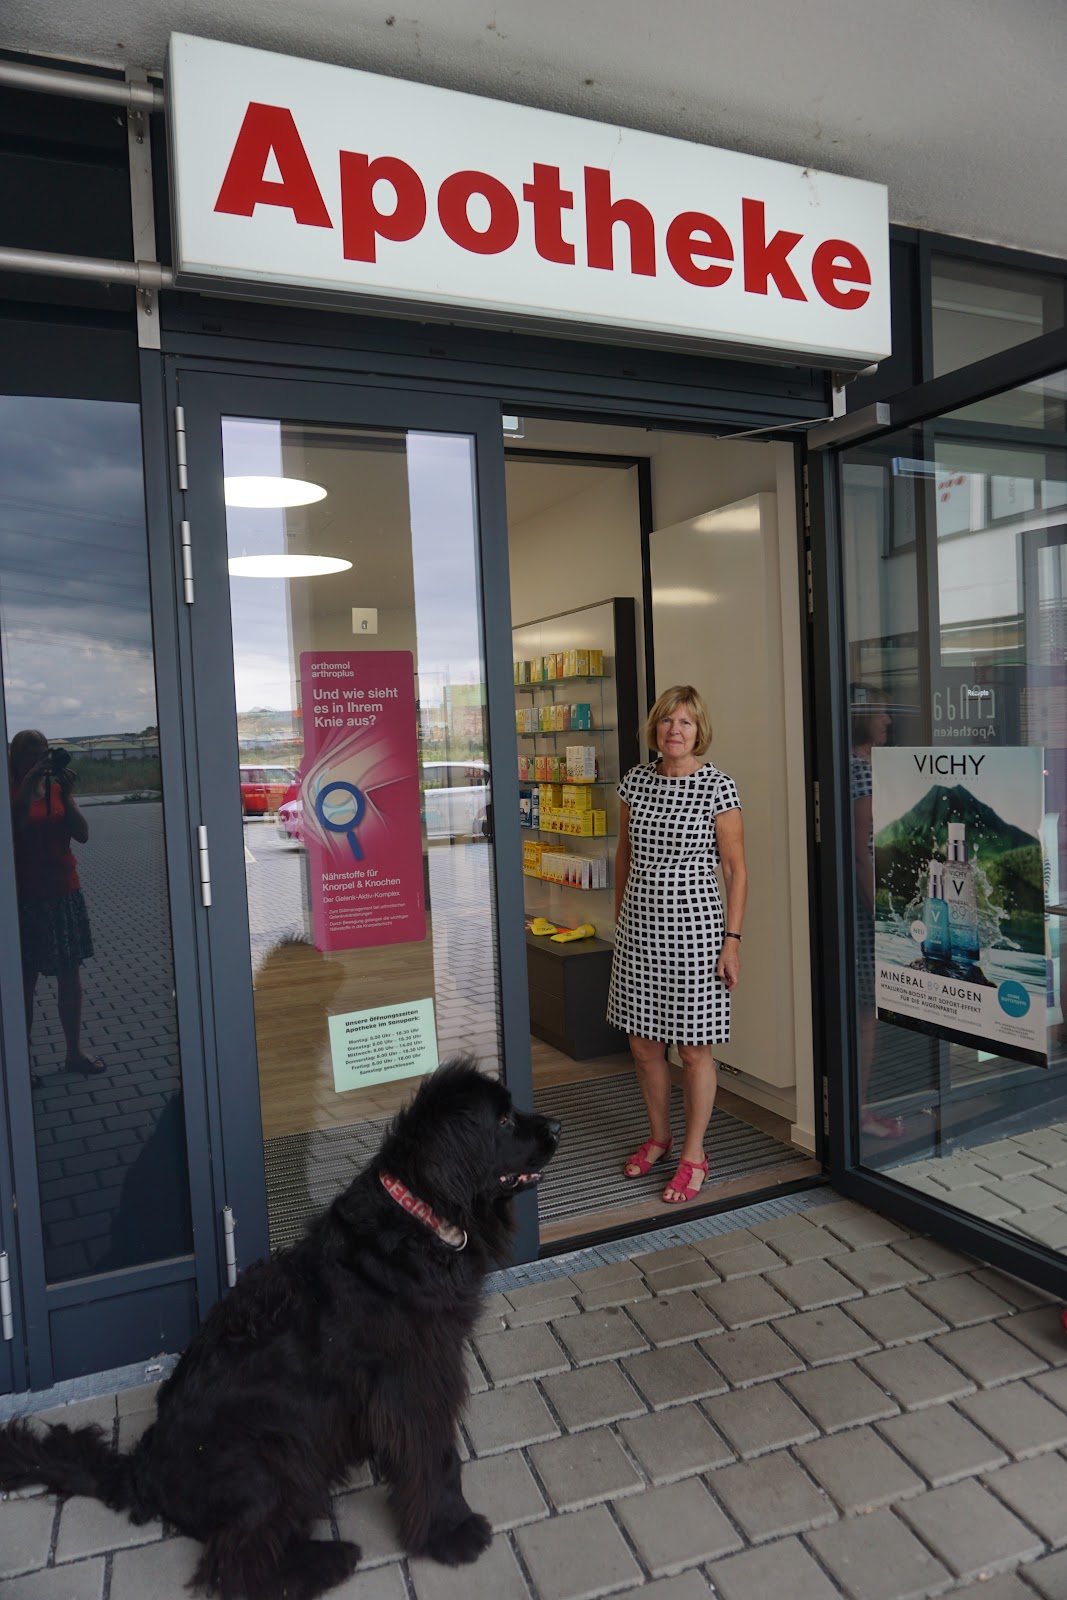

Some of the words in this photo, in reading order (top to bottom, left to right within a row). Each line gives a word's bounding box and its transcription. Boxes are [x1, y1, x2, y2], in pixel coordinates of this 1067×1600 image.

[214, 101, 871, 311] Apotheke
[311, 661, 350, 670] orthomol
[312, 670, 354, 678] arthroplus
[313, 689, 339, 700] Und
[342, 688, 364, 699] wie
[368, 688, 398, 698] sieht
[314, 704, 329, 714] es
[332, 702, 344, 712] in
[347, 702, 383, 712] Ihrem
[314, 716, 344, 728] Knie
[346, 715, 376, 726] aus?
[914, 754, 986, 776] VICHY
[322, 870, 365, 881] Nährstoffe
[366, 869, 378, 878] für
[948, 870, 967, 878] VICHY
[322, 881, 355, 892] Knorpel
[364, 878, 400, 888] Knochen
[952, 880, 964, 896] V
[335, 891, 400, 902] Gelenk-Aktiv-Komplex
[931, 910, 940, 922] V
[951, 904, 966, 920] 89
[913, 928, 925, 936] NEU
[880, 969, 924, 989] MINÉRAL
[926, 979, 940, 991] 89
[941, 985, 982, 1003] AUGEN
[880, 983, 927, 1000] HYALURON-BOOST
[938, 998, 982, 1014] SOFORT-EFFEKT
[900, 994, 910, 1002] FÜR
[921, 999, 958, 1015] AUGENPARTIE
[370, 1010, 418, 1022] Öffnungszeiten
[345, 1024, 377, 1033] Apotheke
